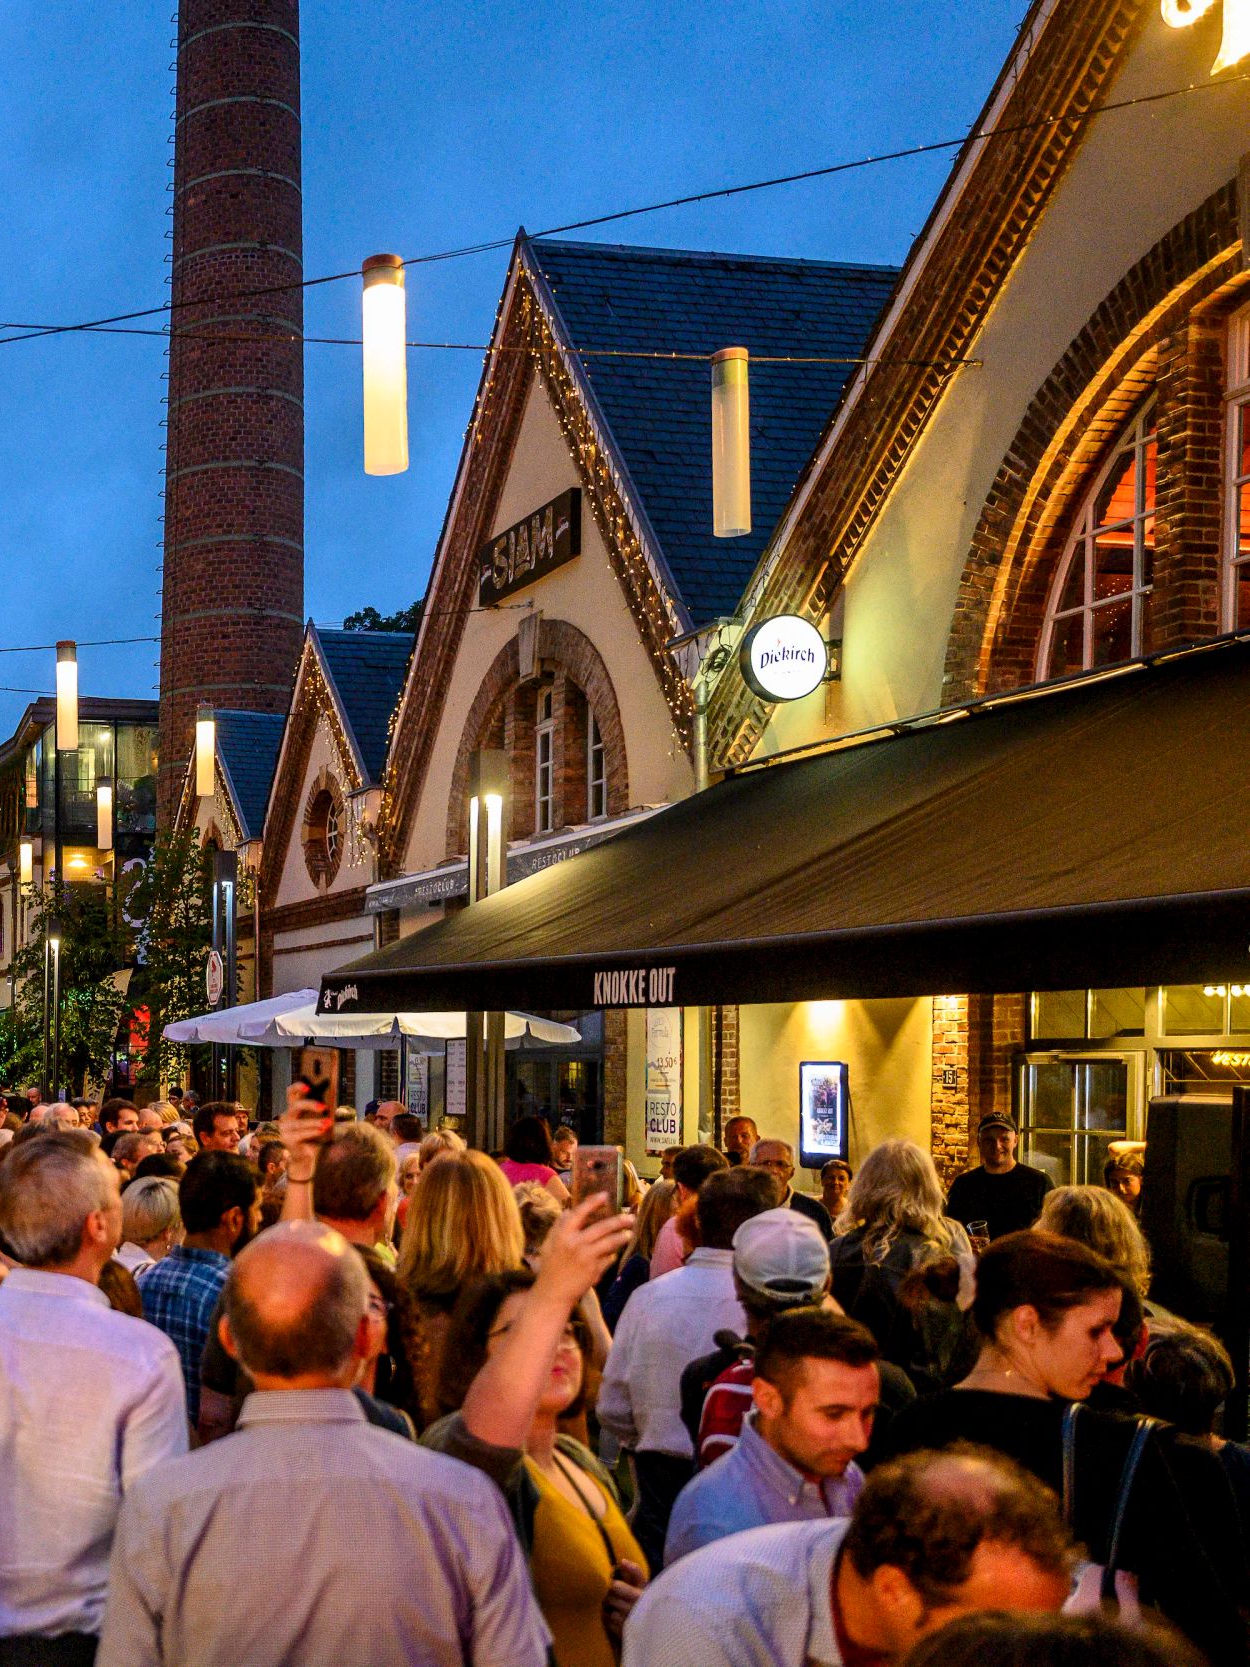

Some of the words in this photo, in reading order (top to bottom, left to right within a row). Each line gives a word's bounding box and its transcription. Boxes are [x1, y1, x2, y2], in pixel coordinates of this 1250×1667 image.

[493, 505, 553, 590] SIAM
[760, 645, 815, 669] Diekirch
[593, 969, 646, 1005] KNOKKE
[649, 967, 676, 1003] OUT
[945, 1070, 954, 1084] 15
[650, 1101, 677, 1117] RESTO
[650, 1118, 676, 1134] CLUB
